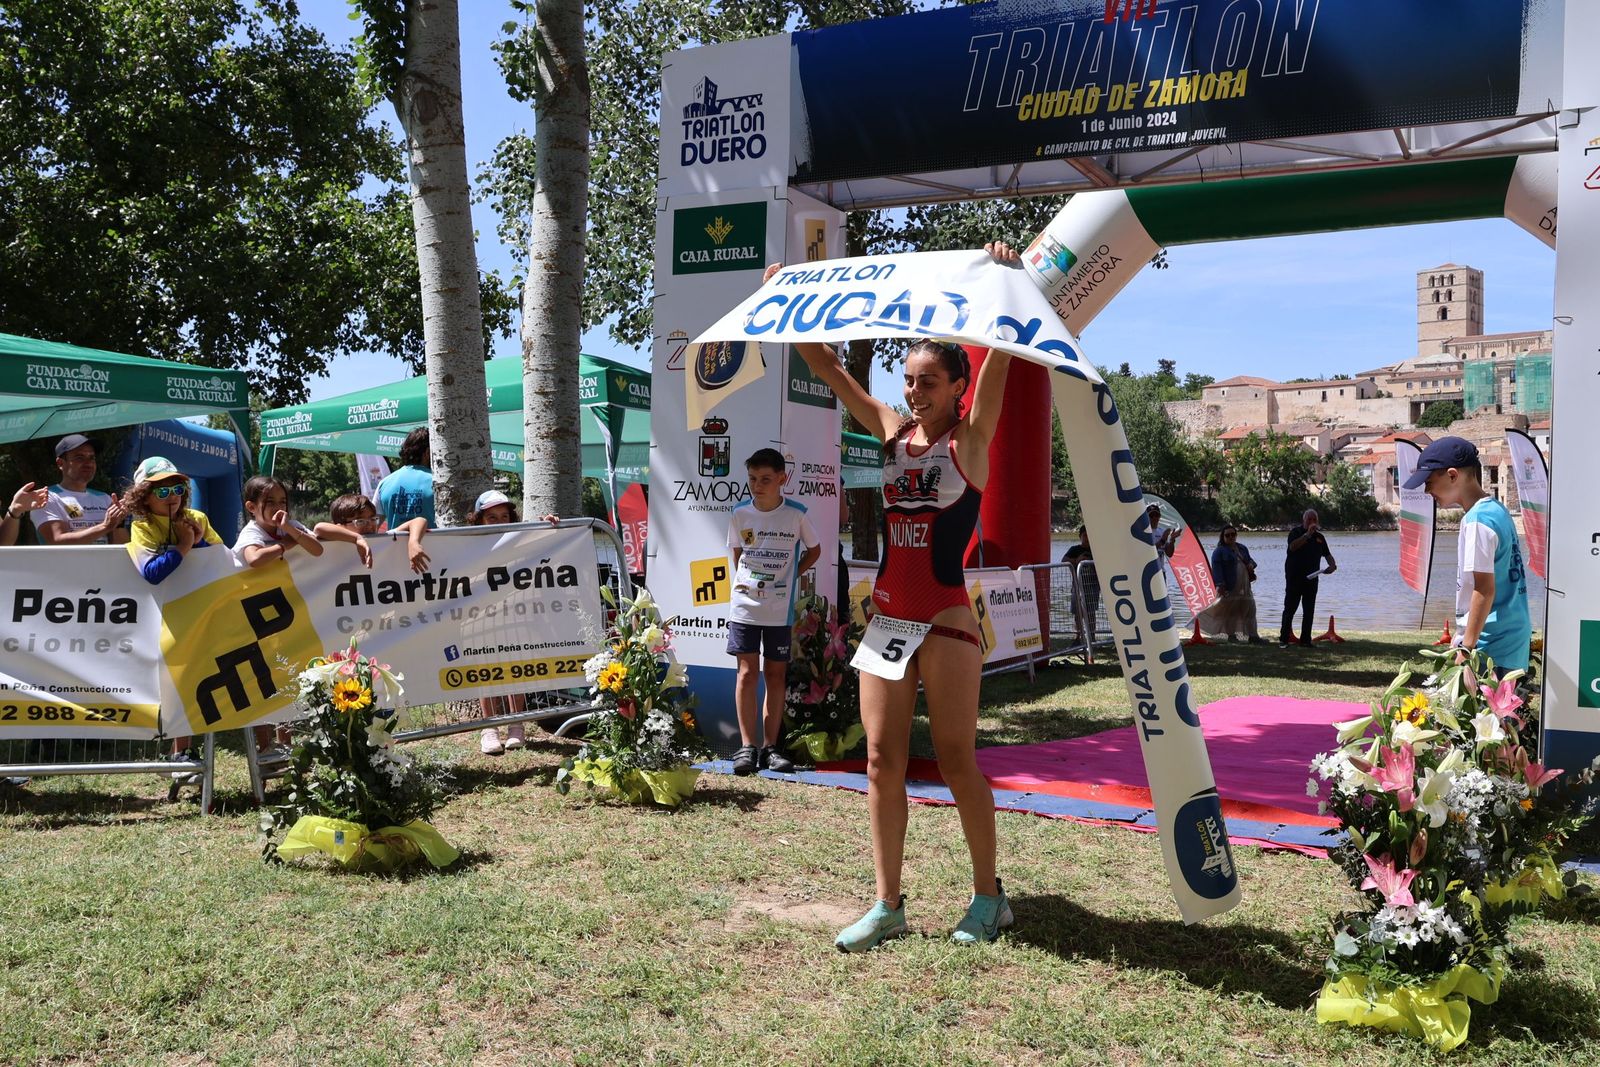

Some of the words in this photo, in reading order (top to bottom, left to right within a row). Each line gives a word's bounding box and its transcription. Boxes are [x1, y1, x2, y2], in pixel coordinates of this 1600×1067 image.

[963, 0, 1318, 112] TRIATLON
[1018, 86, 1099, 122] CIUDAD
[1107, 82, 1139, 112] DE
[1144, 69, 1248, 108] ZAMORA
[682, 111, 764, 140] TRIATLON
[1081, 121, 1087, 133] 1
[1091, 118, 1105, 132] de
[1109, 115, 1143, 131] Junio
[1147, 111, 1177, 127] 2024
[681, 133, 767, 166] DUERO
[1044, 140, 1099, 155] CAMPEONATO
[1102, 138, 1112, 149] DE
[1115, 137, 1130, 148] CYL
[1133, 136, 1144, 147] DE
[1147, 131, 1187, 145] TRIATLON
[1191, 127, 1227, 141] JUVENIL
[680, 248, 710, 264] CAJA
[714, 246, 758, 260] RURAL
[776, 263, 896, 286] TRIATLON
[1049, 244, 1110, 308] UNTAMIENTO
[1057, 308, 1069, 320] E
[1066, 255, 1122, 311] ZAMORA
[744, 290, 970, 336] CIUDAD
[27, 376, 61, 390] CAJA
[64, 380, 111, 393] RURAL
[167, 388, 196, 400] CAJA
[198, 391, 237, 402] RURAL
[579, 388, 599, 400] RAL
[628, 383, 651, 398] CAJA
[791, 378, 808, 393] CAJA
[810, 379, 833, 398] RURAL
[348, 415, 368, 425] CAJA
[370, 409, 398, 422] RURAL
[266, 428, 285, 438] CAJA
[287, 422, 312, 434] RURAL
[190, 438, 199, 451] DE
[200, 442, 229, 459] ZAMORA
[848, 446, 861, 457] CAJA
[673, 481, 752, 502] ZAMORA
[799, 480, 838, 497] ZAMORA
[687, 504, 734, 513] AYUNTAMIENT
[890, 518, 929, 549] NÚÑEZ
[334, 568, 473, 608] Martín
[486, 558, 579, 592] Peña
[12, 588, 138, 624] Peña
[989, 588, 1015, 606] Martín
[1015, 586, 1033, 603] Peña
[337, 598, 581, 634] Construcciones
[463, 646, 495, 656] Martín
[498, 642, 521, 653] Peña
[523, 640, 585, 651] Construcciones
[881, 638, 907, 663] 5
[1109, 574, 1164, 742] TRIATLON
[466, 667, 505, 683] 692
[510, 663, 549, 679] 988
[555, 658, 588, 674] 227
[13, 682, 45, 692] Peña
[49, 685, 132, 694] Construcciones
[27, 705, 75, 721] 988
[85, 708, 132, 723] 227
